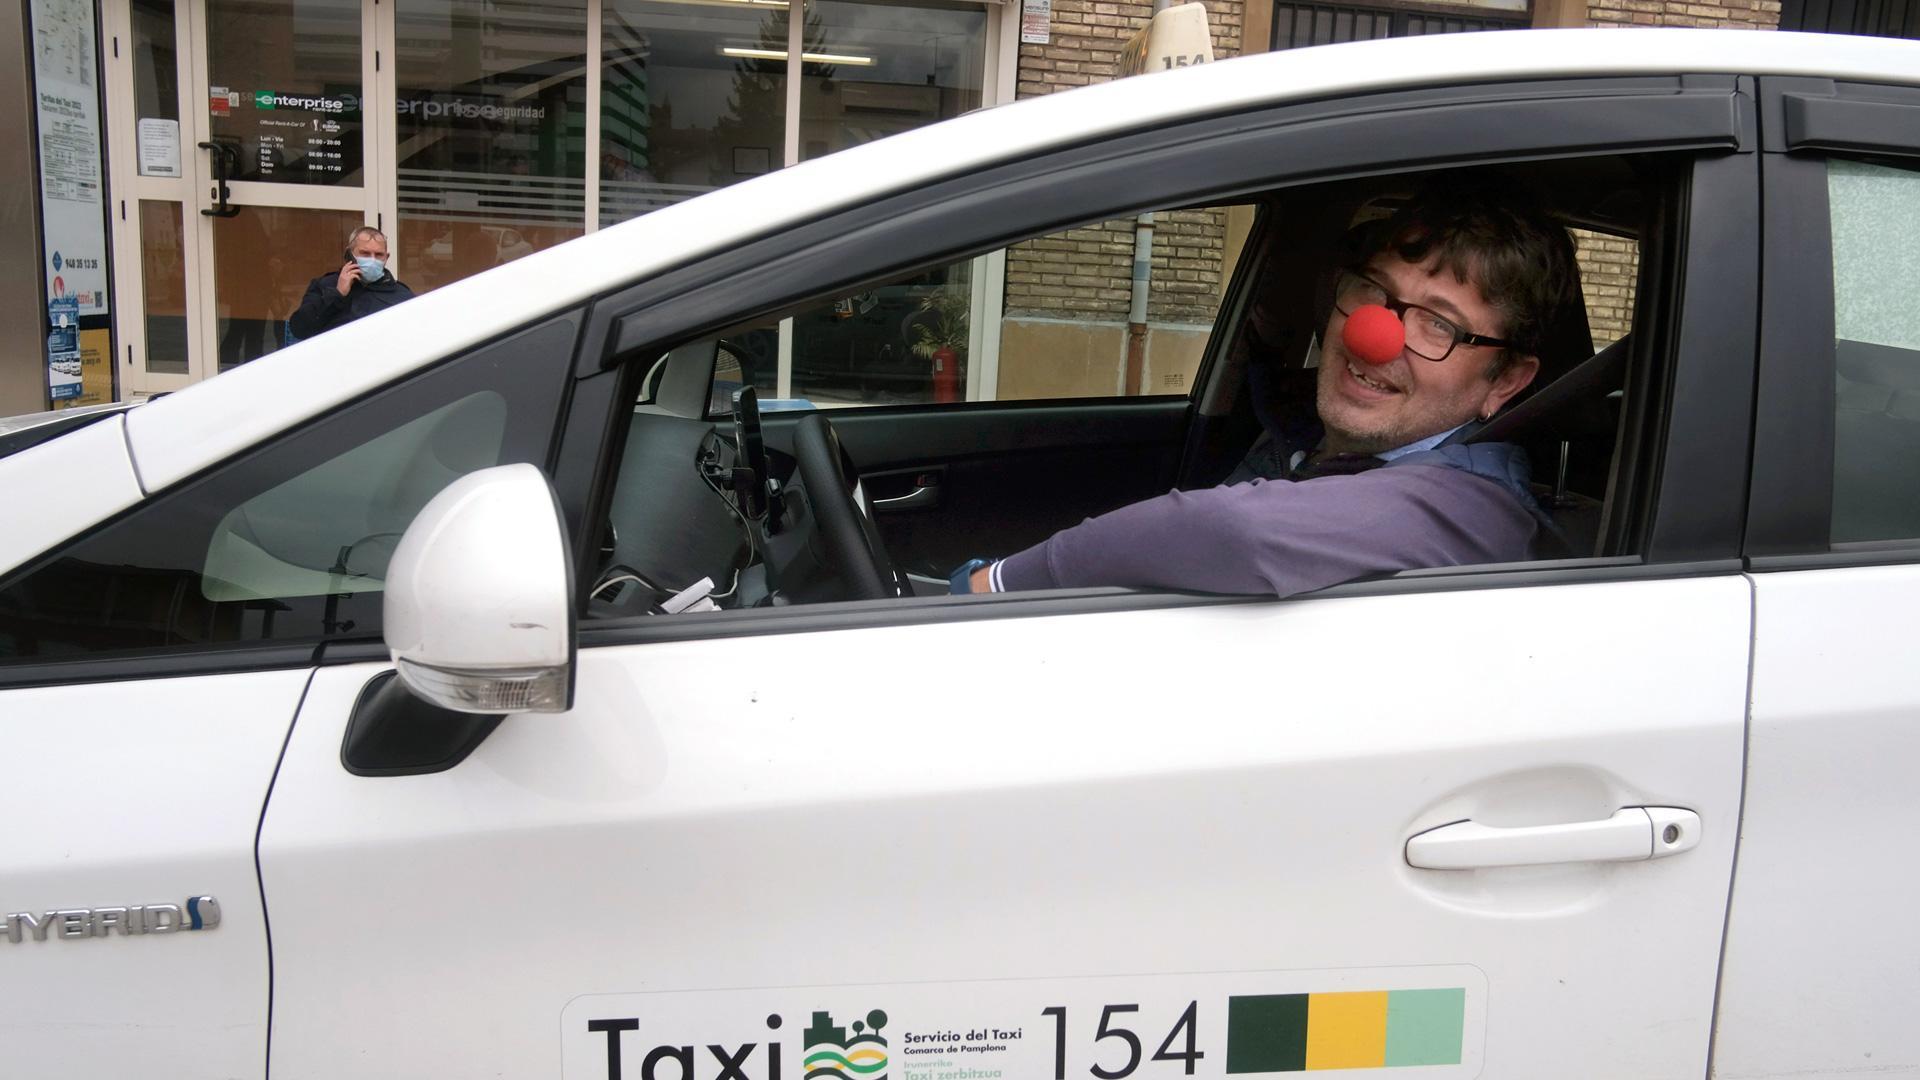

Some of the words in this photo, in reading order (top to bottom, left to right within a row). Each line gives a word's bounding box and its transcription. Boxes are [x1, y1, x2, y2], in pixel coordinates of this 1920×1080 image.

[1162, 54, 1204, 69] 154
[256, 95, 343, 109] enterprise
[904, 1031, 961, 1043] Servicio
[966, 1029, 987, 1041] del
[992, 1028, 1022, 1040] Taxi
[1041, 1000, 1204, 1080] 154
[588, 1014, 782, 1080] Taxi
[904, 1047, 944, 1055] Comarca
[946, 1045, 958, 1053] de
[961, 1044, 1007, 1054] Pamplona
[904, 1070, 933, 1080] Taxi
[937, 1068, 1002, 1080] zerbitzua
